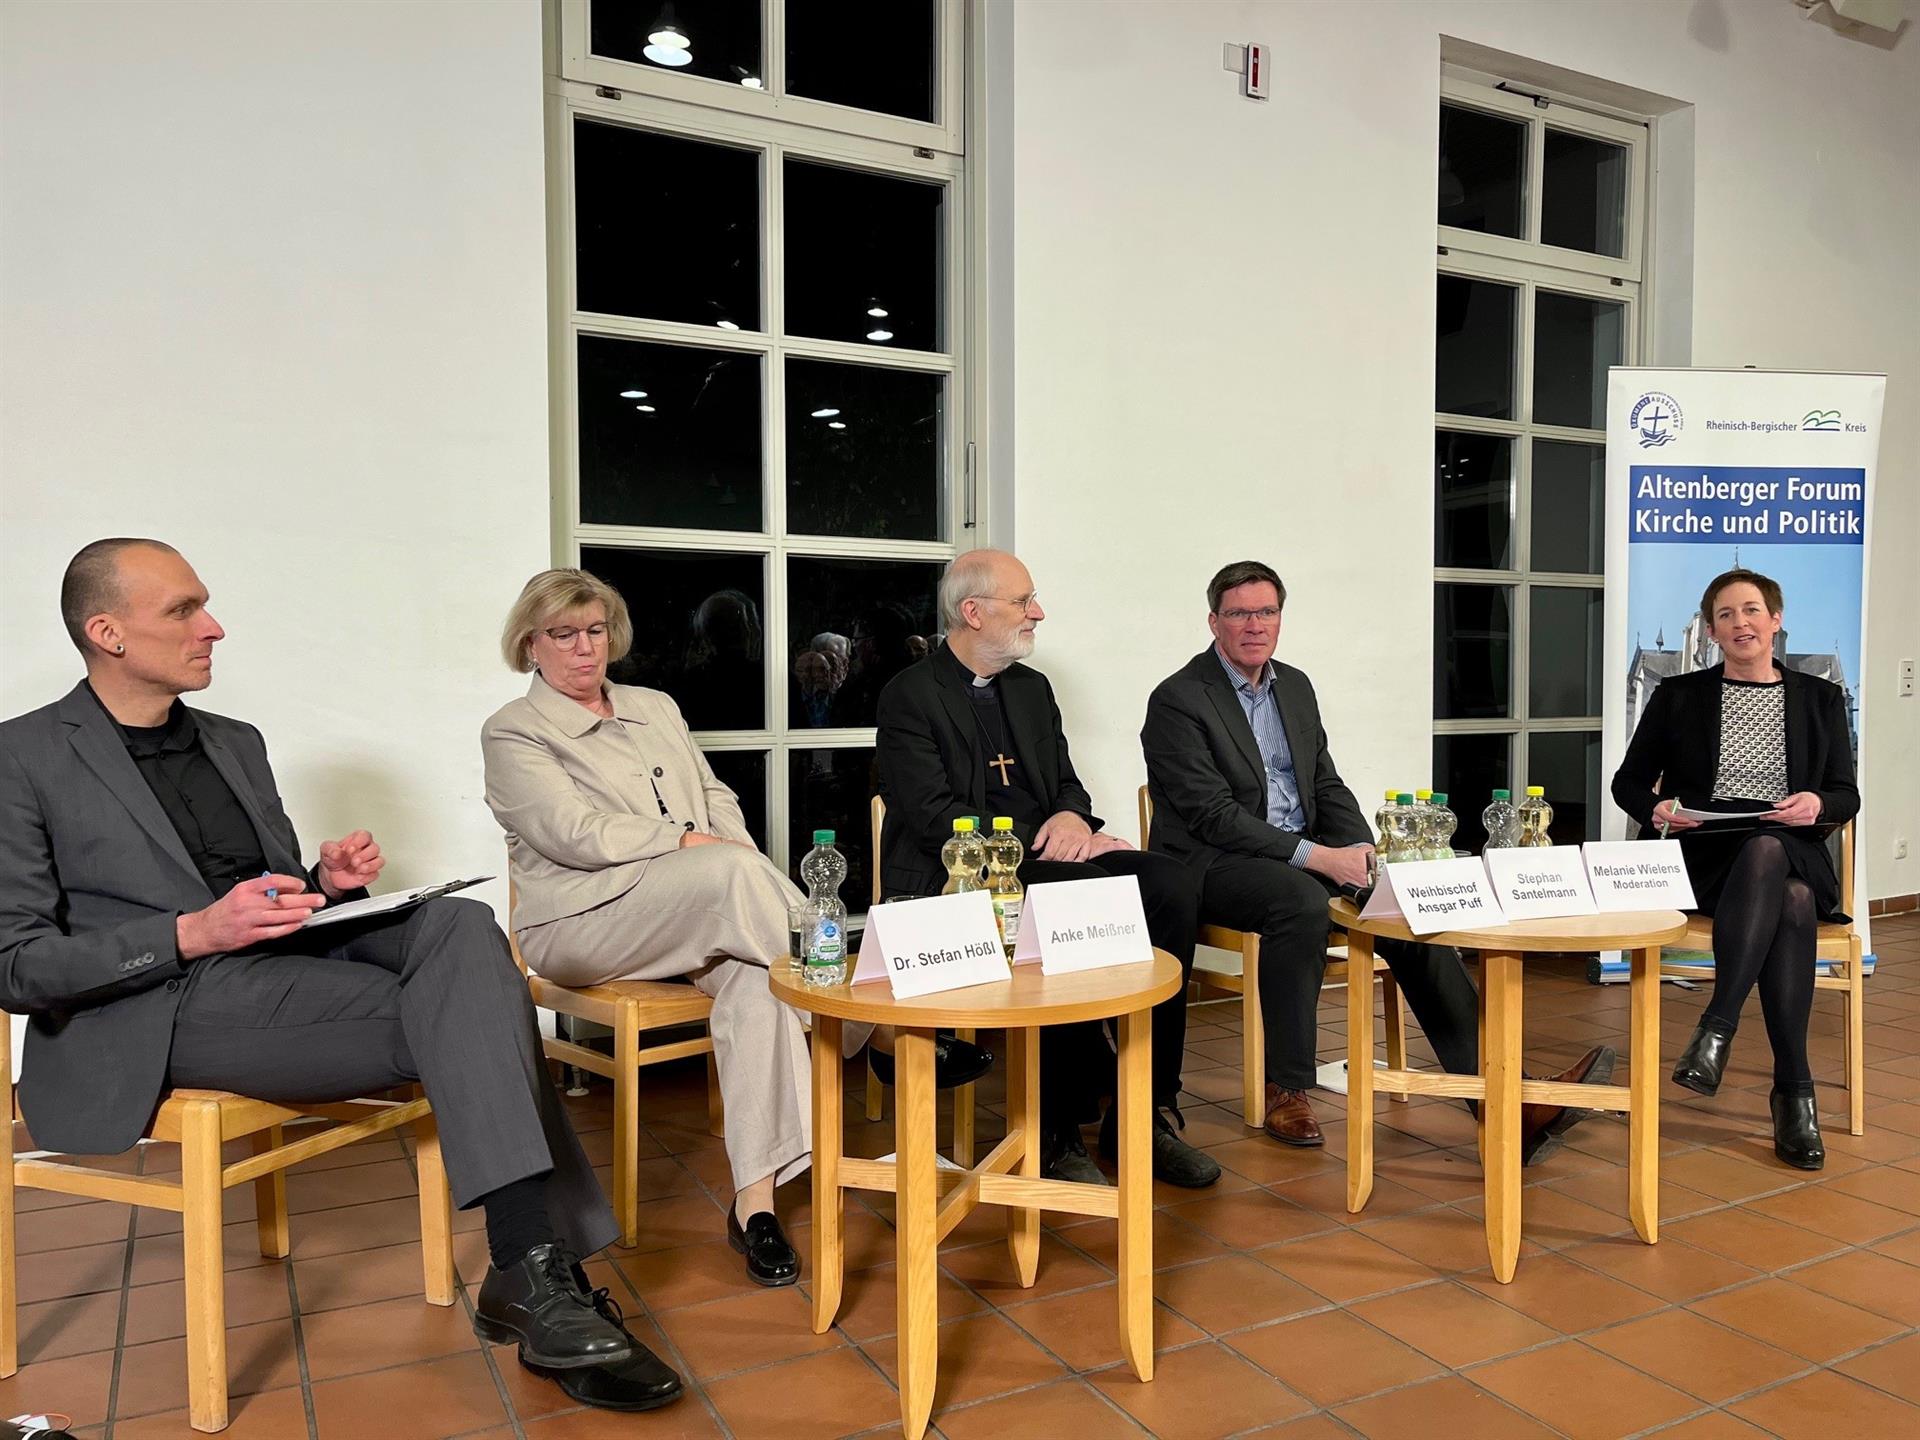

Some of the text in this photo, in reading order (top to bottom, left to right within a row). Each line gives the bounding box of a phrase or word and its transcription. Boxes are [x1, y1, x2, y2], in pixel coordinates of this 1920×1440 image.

[1706, 420, 1867, 434] Rheinisch-Bergischer Kreis
[1637, 474, 1862, 506] Altenberger Forum
[1635, 509, 1860, 534] Kirche und Politik
[1593, 863, 1681, 877] Melanie Wielens
[1517, 872, 1563, 886] Stephan
[1613, 879, 1669, 890] Moderation
[1407, 881, 1478, 899] Weihbischof
[1512, 888, 1577, 900] Santelmann
[1417, 897, 1483, 914] Ansgar Puff
[1051, 923, 1136, 944] Anke Meißner
[893, 941, 996, 971] Dr. Stefan Hößl
